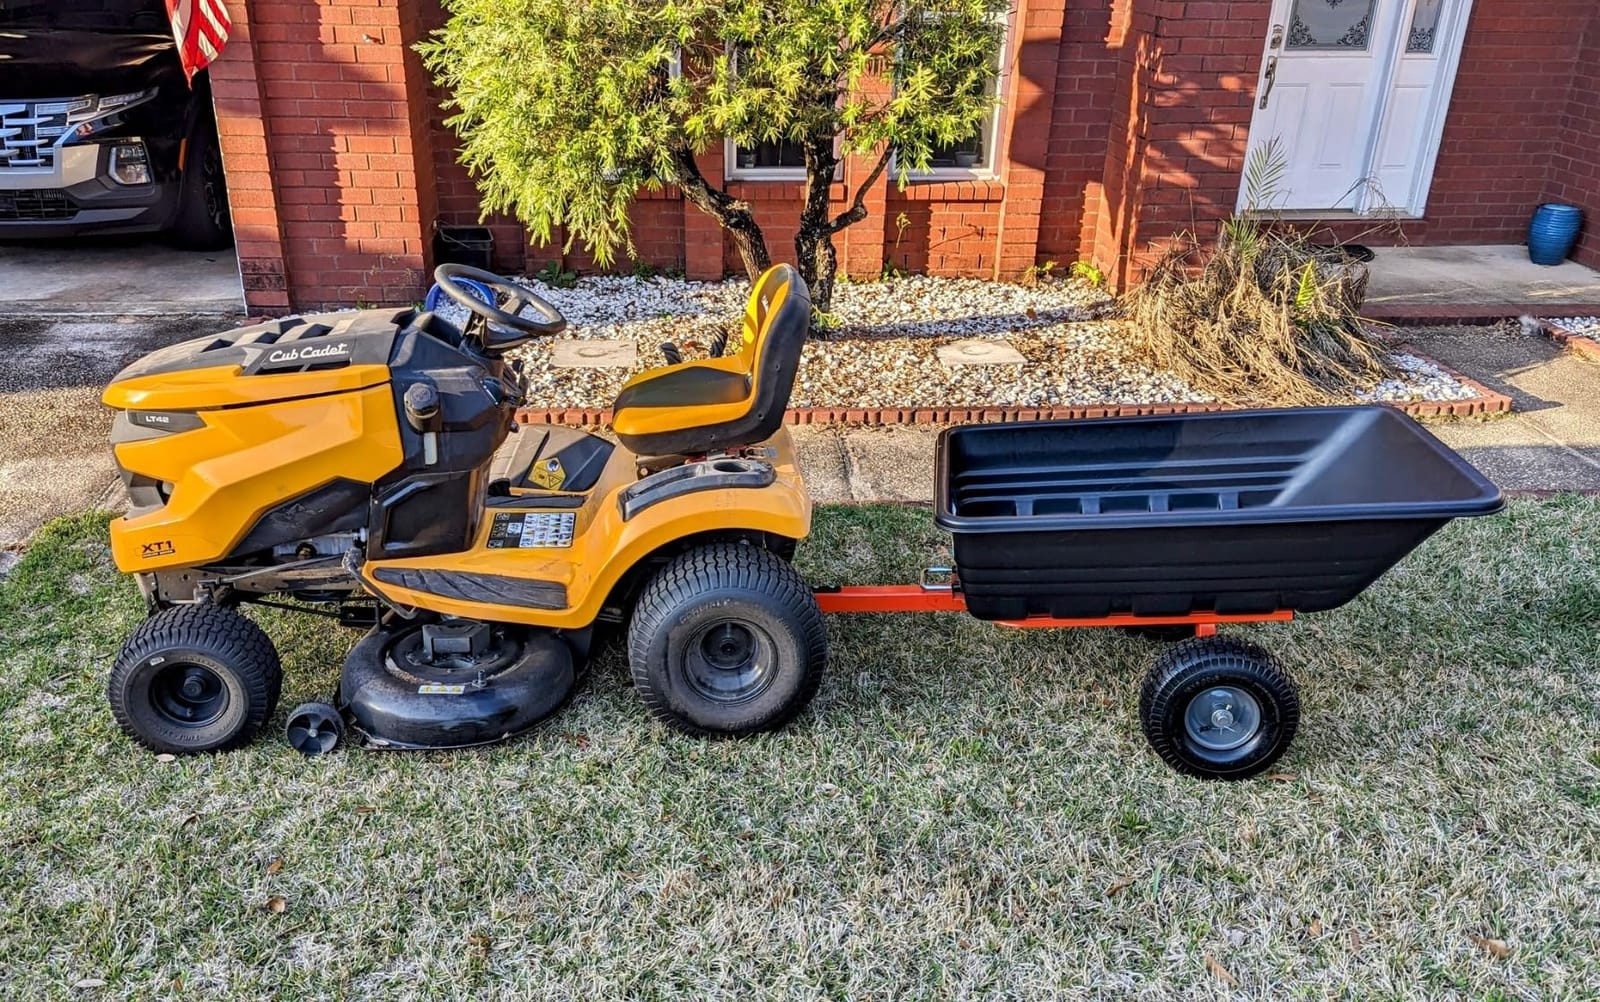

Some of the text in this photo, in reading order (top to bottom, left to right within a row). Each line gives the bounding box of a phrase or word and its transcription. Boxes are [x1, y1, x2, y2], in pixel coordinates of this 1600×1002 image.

[269, 343, 348, 362] Cub Cadet
[145, 415, 170, 423] LT42
[142, 540, 172, 553] XT1
